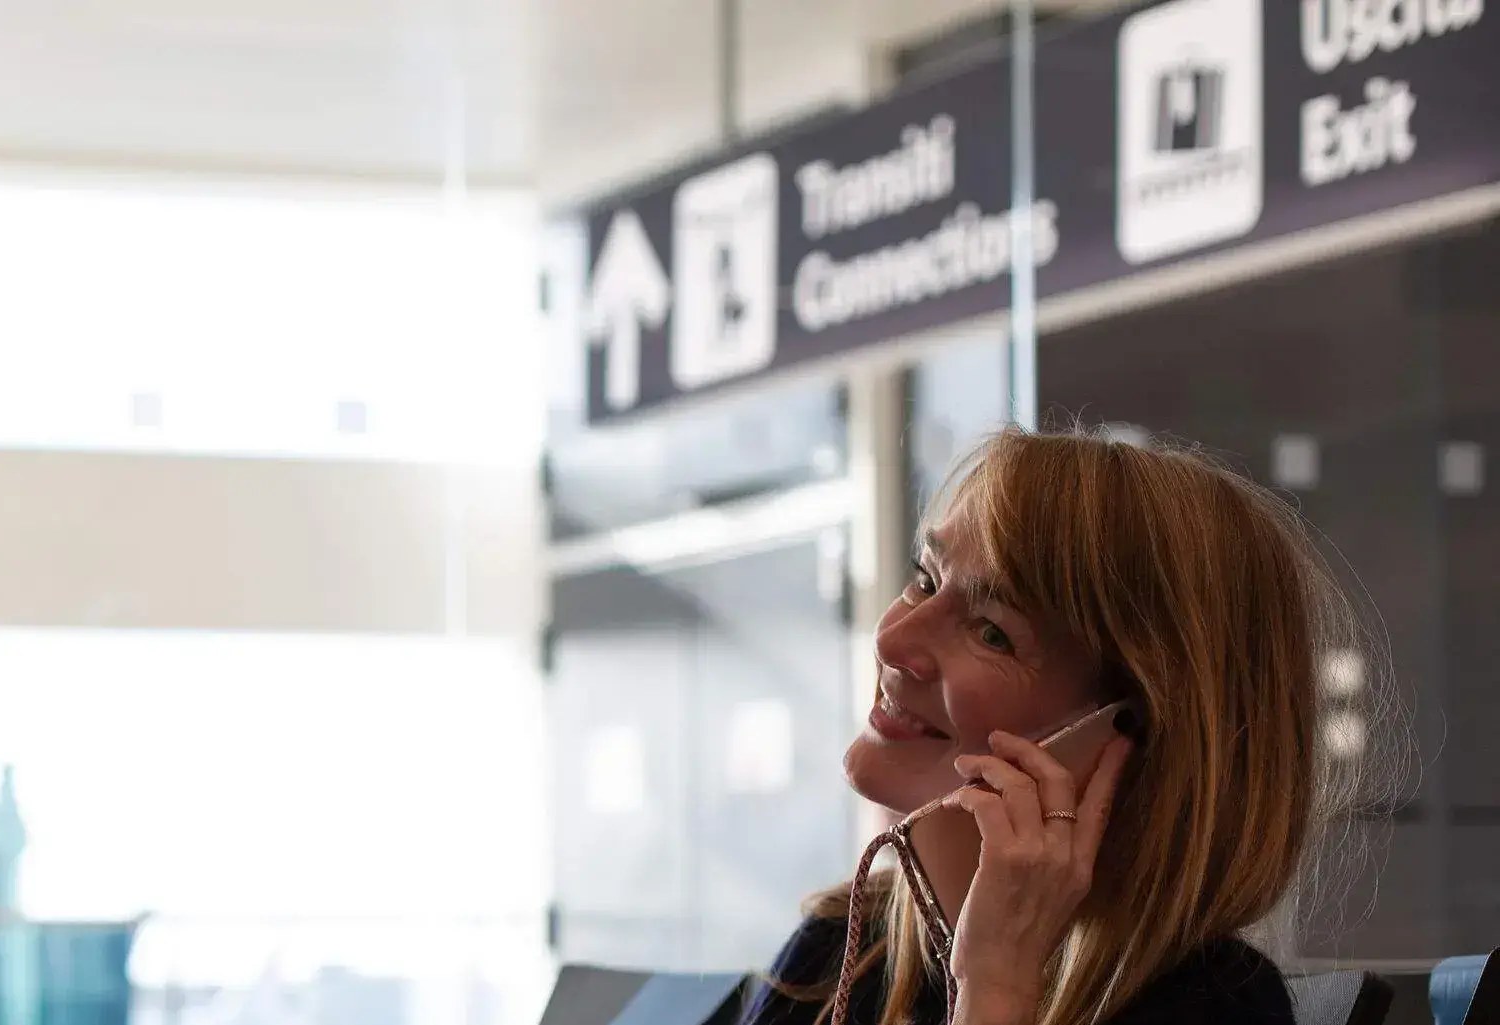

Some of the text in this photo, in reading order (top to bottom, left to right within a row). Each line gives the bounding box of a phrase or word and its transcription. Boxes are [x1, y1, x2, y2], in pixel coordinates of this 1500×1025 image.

[796, 114, 954, 238] Transiti
[1301, 77, 1415, 186] Exit
[794, 200, 1057, 331] Connections
